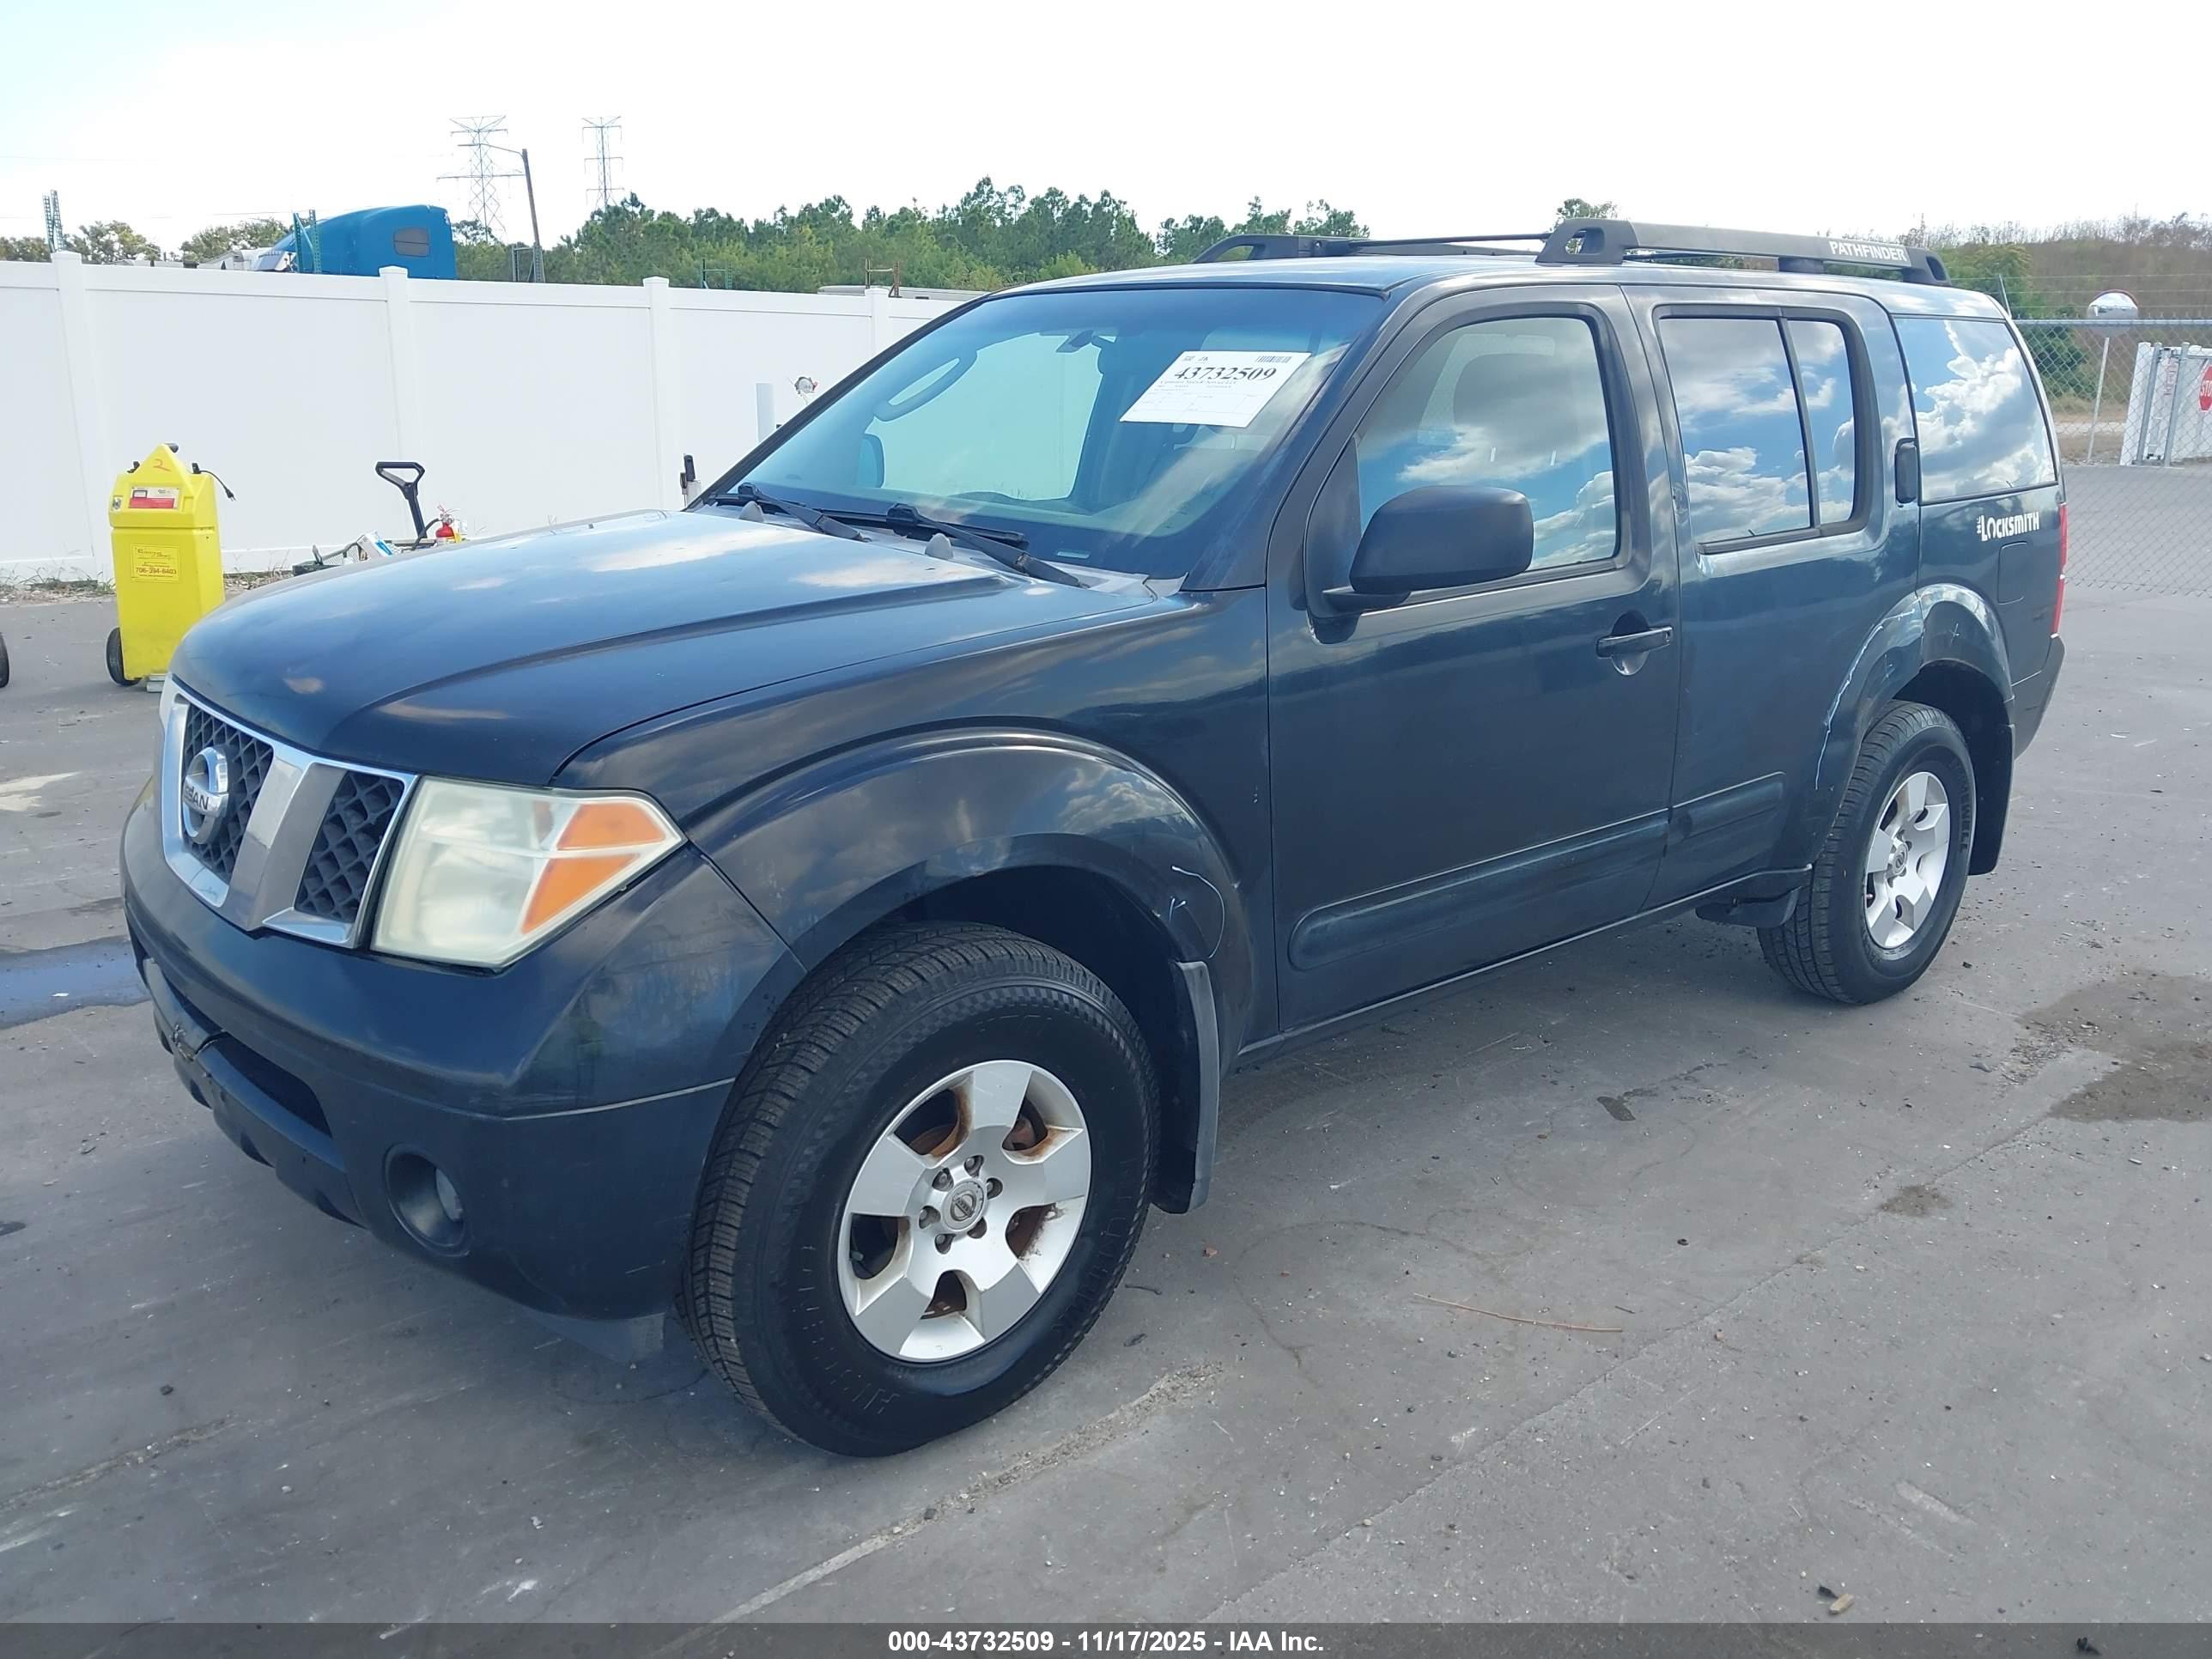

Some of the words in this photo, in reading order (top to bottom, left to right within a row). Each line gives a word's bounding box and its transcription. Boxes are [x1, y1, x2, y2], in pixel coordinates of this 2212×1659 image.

[1830, 241, 1907, 261] PATHFINDER
[1175, 367, 1278, 381] 43732509
[153, 459, 172, 472] 2
